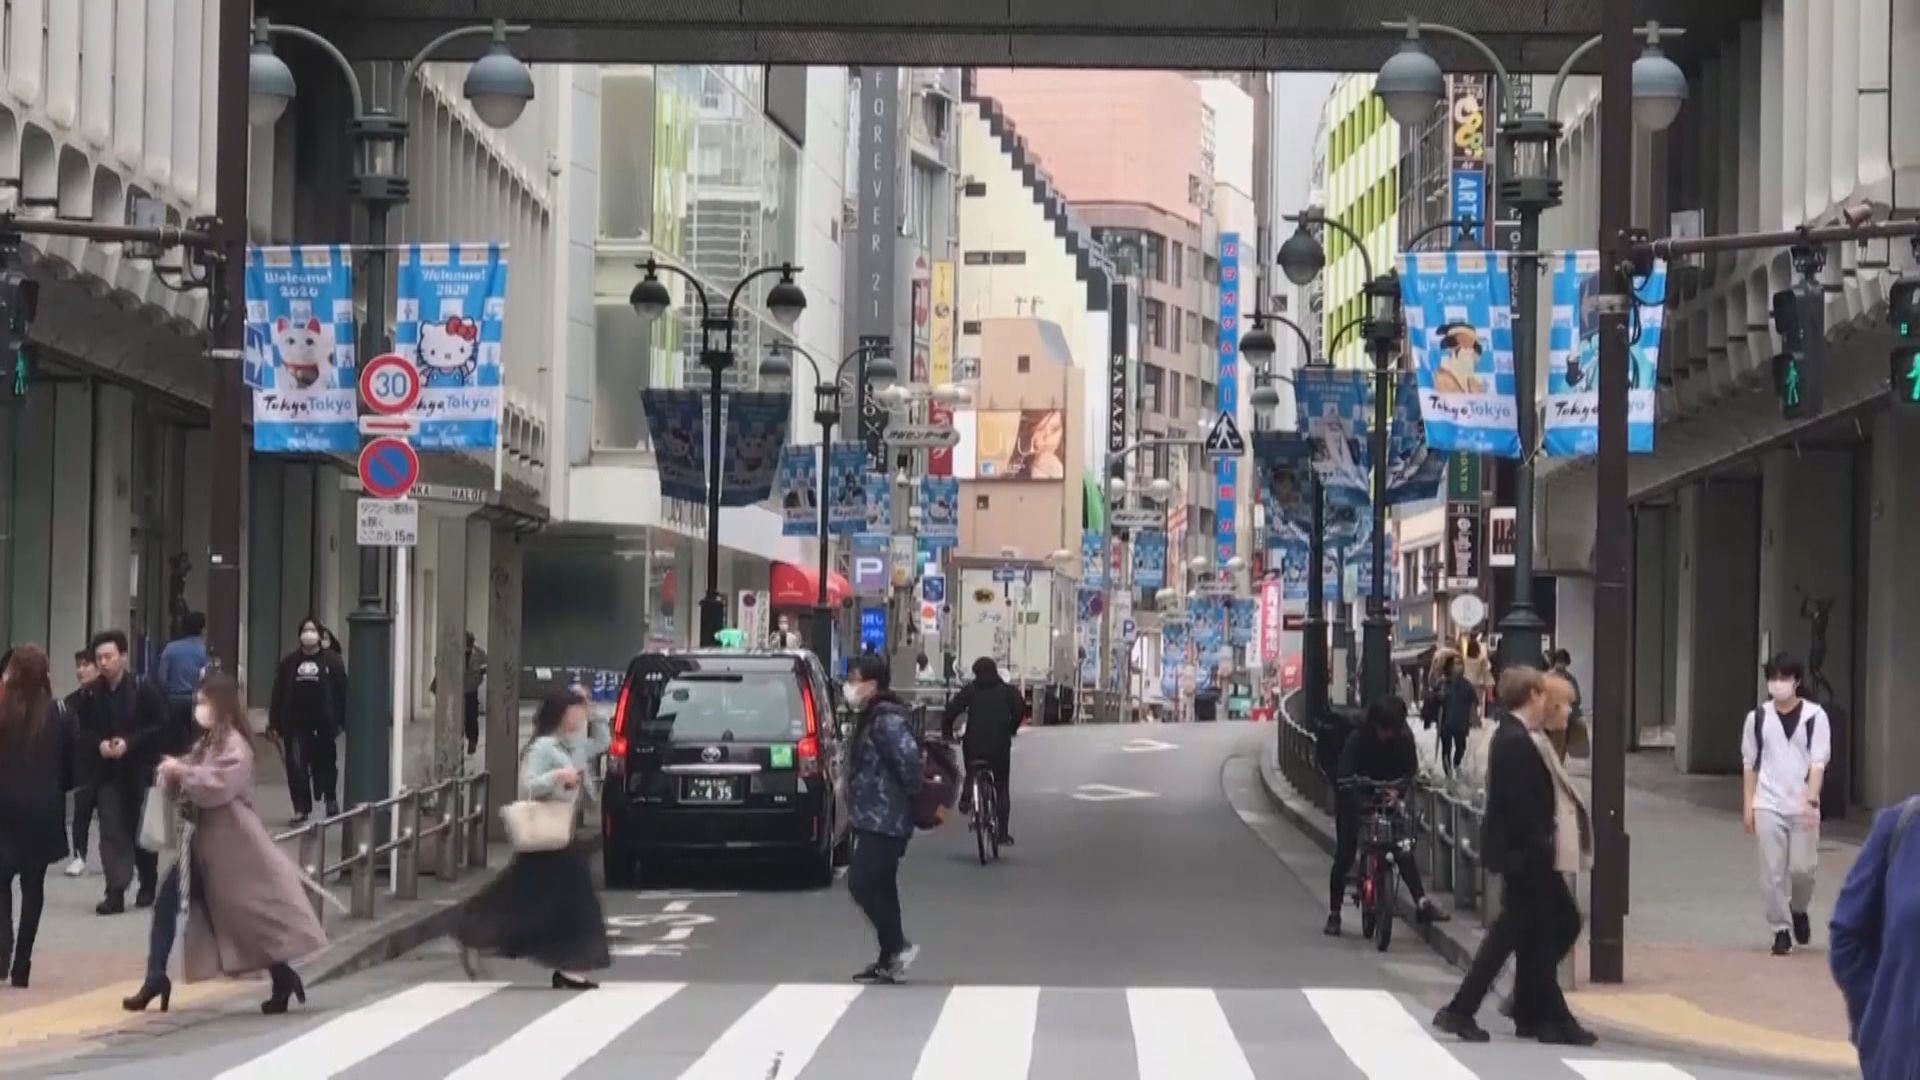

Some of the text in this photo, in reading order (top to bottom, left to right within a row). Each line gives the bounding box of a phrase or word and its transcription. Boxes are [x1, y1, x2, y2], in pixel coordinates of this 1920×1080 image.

[871, 71, 884, 318] FOREVER 21
[264, 270, 332, 284] Welcome!
[280, 285, 319, 298] 2020
[374, 371, 408, 398] 30
[263, 395, 353, 418] Tokyo Tokyo
[445, 395, 490, 413] Tokyo
[1112, 354, 1124, 449] SAKAZE
[1430, 396, 1511, 418] Tokyo Tokyo
[1556, 402, 1598, 422] Tokyo
[856, 557, 883, 584] P
[1123, 620, 1136, 638] P
